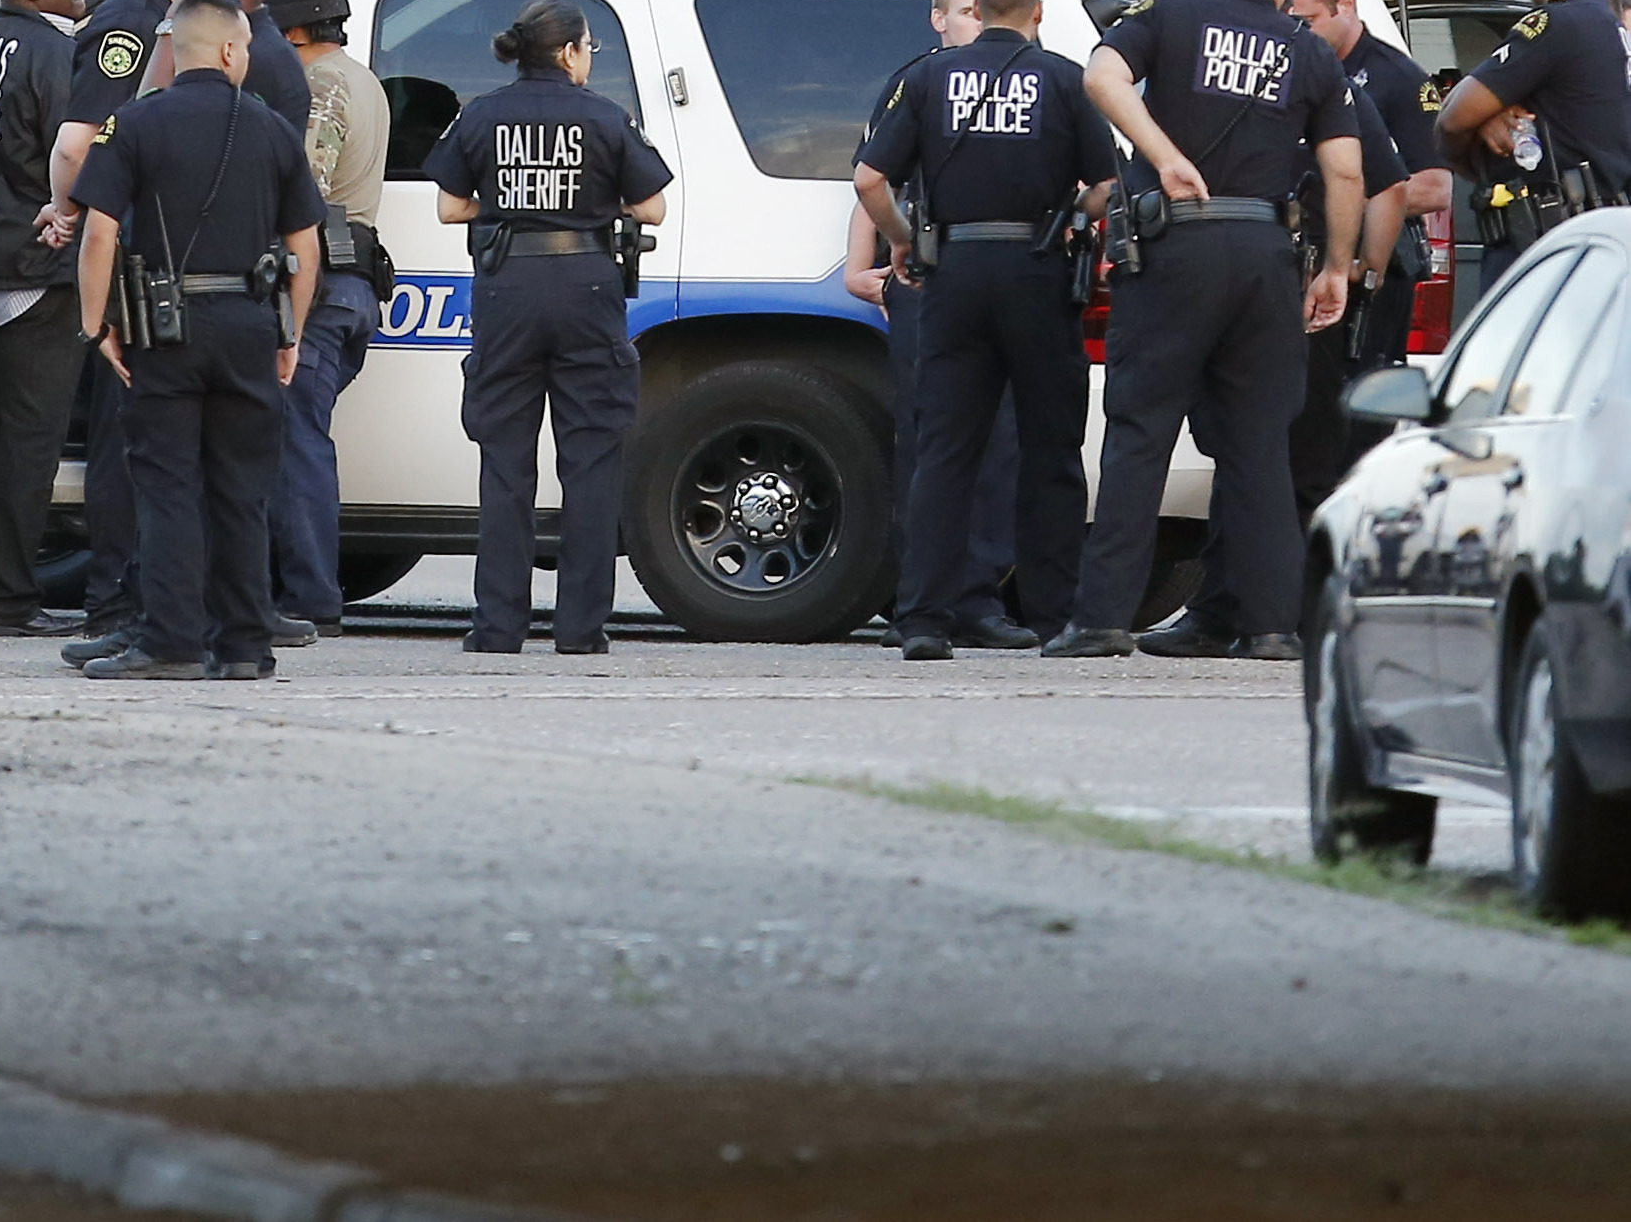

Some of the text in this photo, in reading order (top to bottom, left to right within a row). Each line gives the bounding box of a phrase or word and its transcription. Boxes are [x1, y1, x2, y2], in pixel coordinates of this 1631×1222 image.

[1204, 27, 1290, 78] DALLAS
[947, 71, 1039, 103] DALLAS
[1204, 57, 1280, 102] POLICE
[952, 100, 1032, 134] POLICE
[495, 124, 583, 167] DALLAS
[497, 168, 583, 210] SHERIFF
[377, 283, 473, 337] OL
